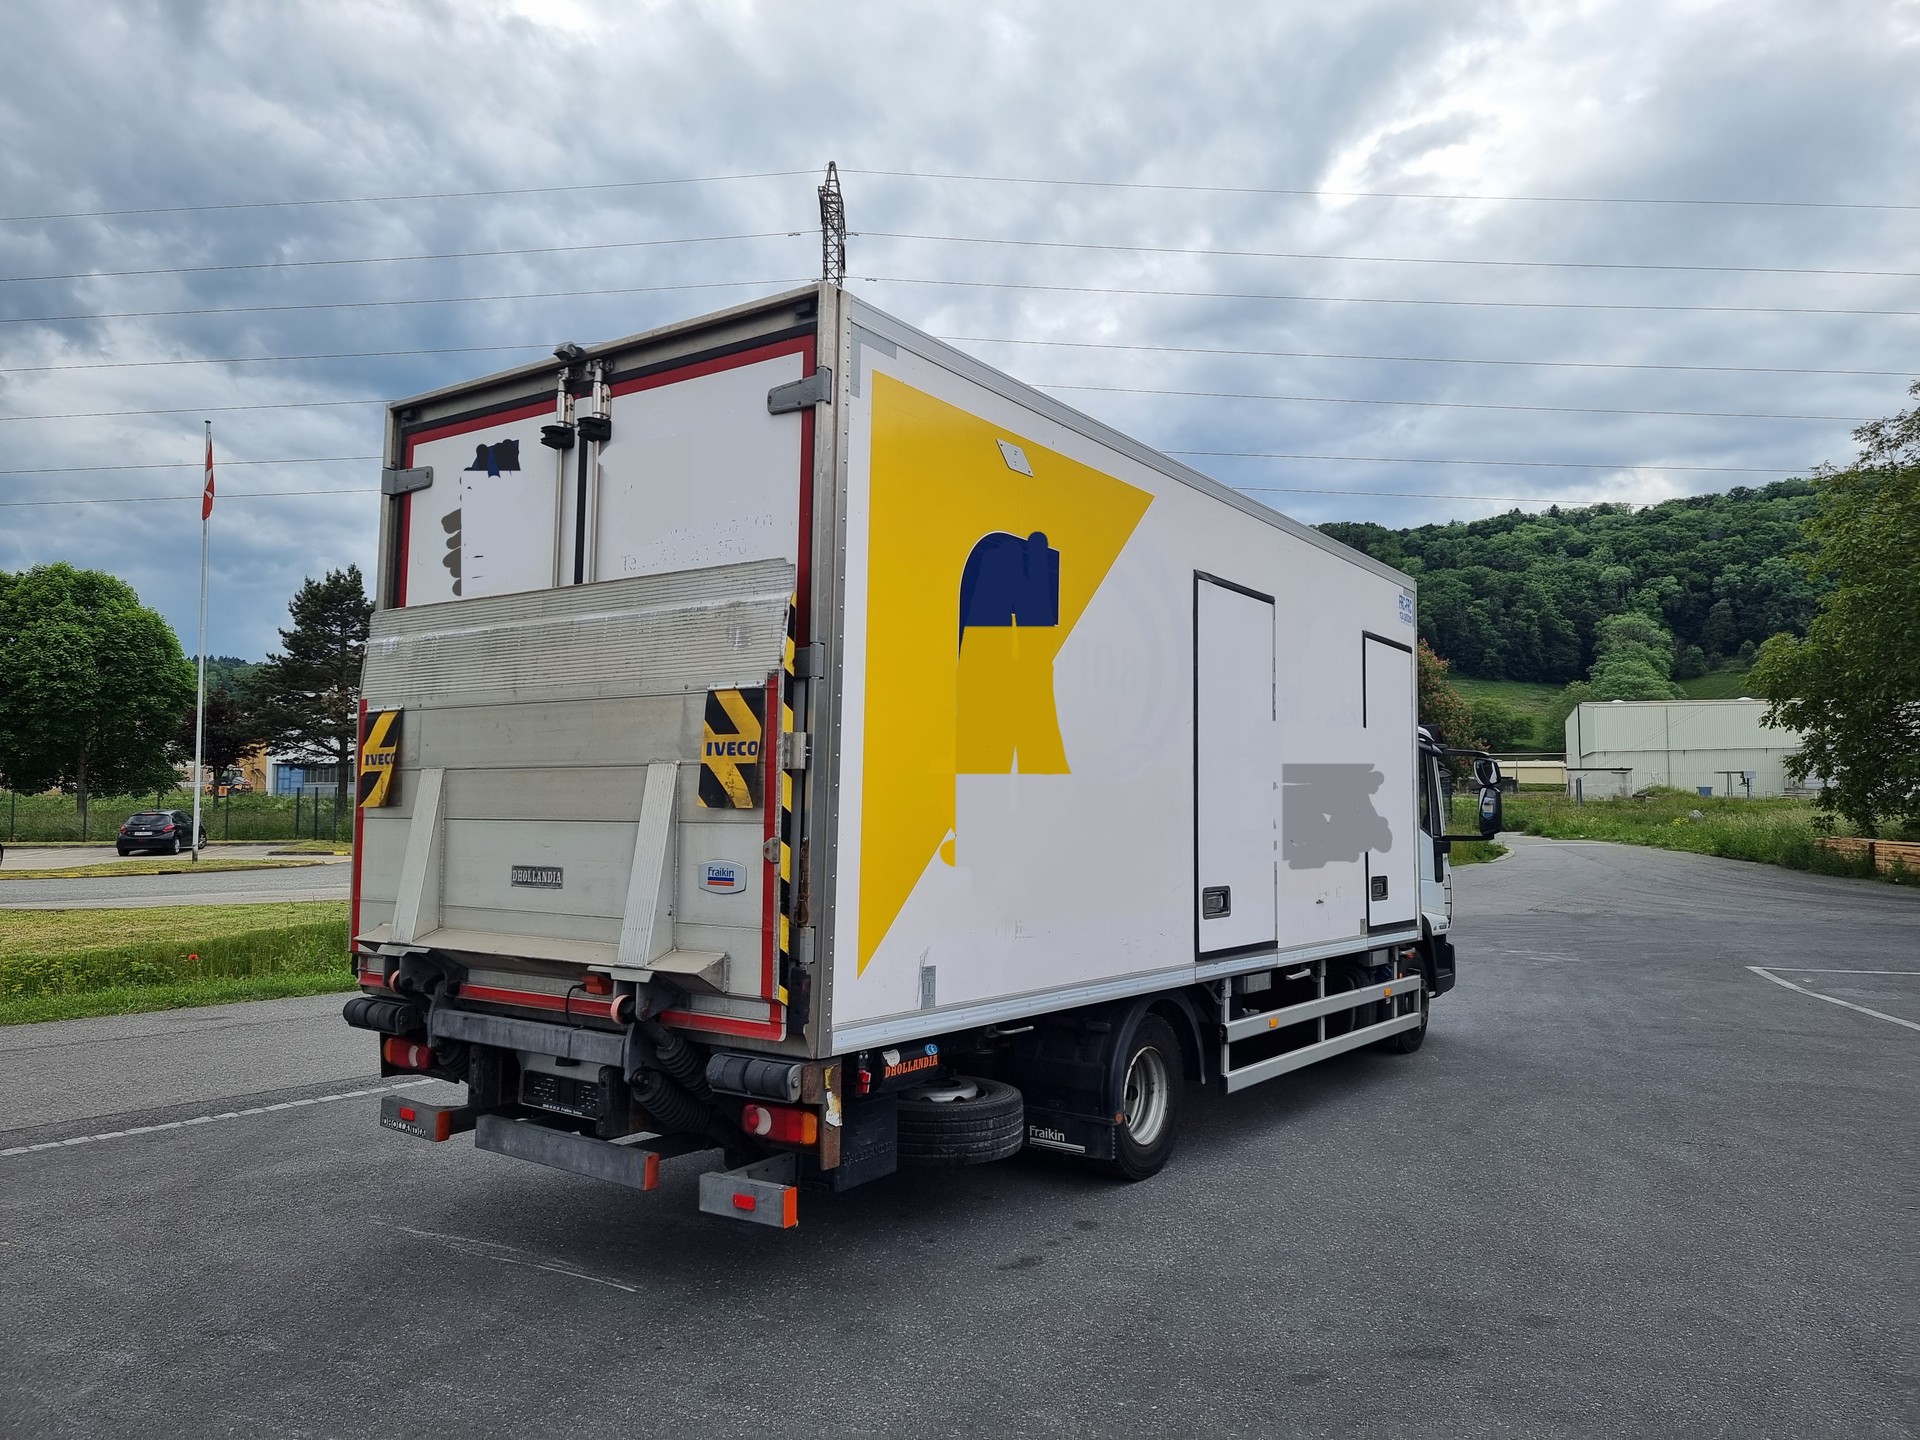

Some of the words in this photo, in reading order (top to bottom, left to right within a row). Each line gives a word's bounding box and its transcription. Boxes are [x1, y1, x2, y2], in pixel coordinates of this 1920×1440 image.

[706, 741, 759, 756] IVECO
[512, 870, 562, 883] DHOLLANDIA
[707, 866, 735, 877] Fraikin
[884, 1055, 938, 1078] DHOLLANDIA
[1029, 1125, 1065, 1142] Fraikin
